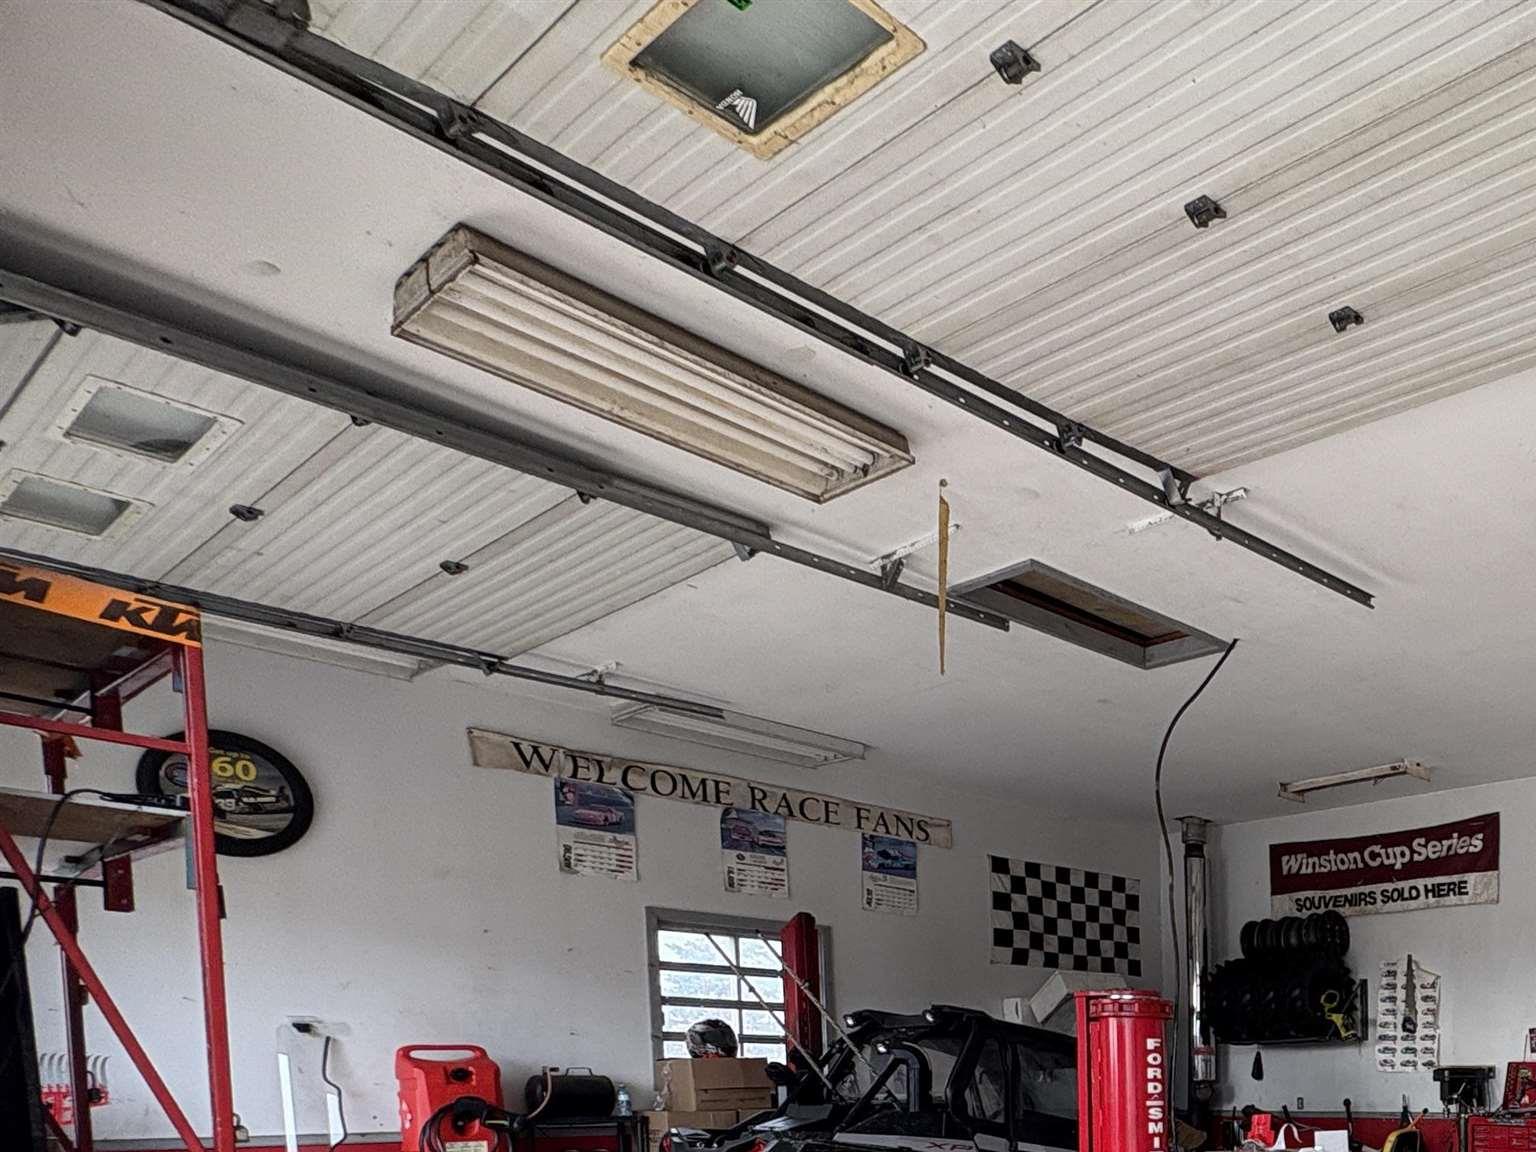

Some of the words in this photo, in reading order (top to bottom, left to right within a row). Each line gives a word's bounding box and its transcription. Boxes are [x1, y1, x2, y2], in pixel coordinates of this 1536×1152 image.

[211, 756, 258, 782] 60
[509, 740, 736, 807] WELCOME
[748, 786, 843, 826] RACE
[853, 807, 931, 844] FANS
[1281, 850, 1364, 876] Winston
[1364, 844, 1411, 870] Cup
[1412, 832, 1485, 863] Series
[1294, 890, 1378, 913] SOUVENIRS
[1379, 884, 1422, 905] SOLD
[1423, 879, 1470, 901] HERE
[926, 1141, 974, 1151] XP
